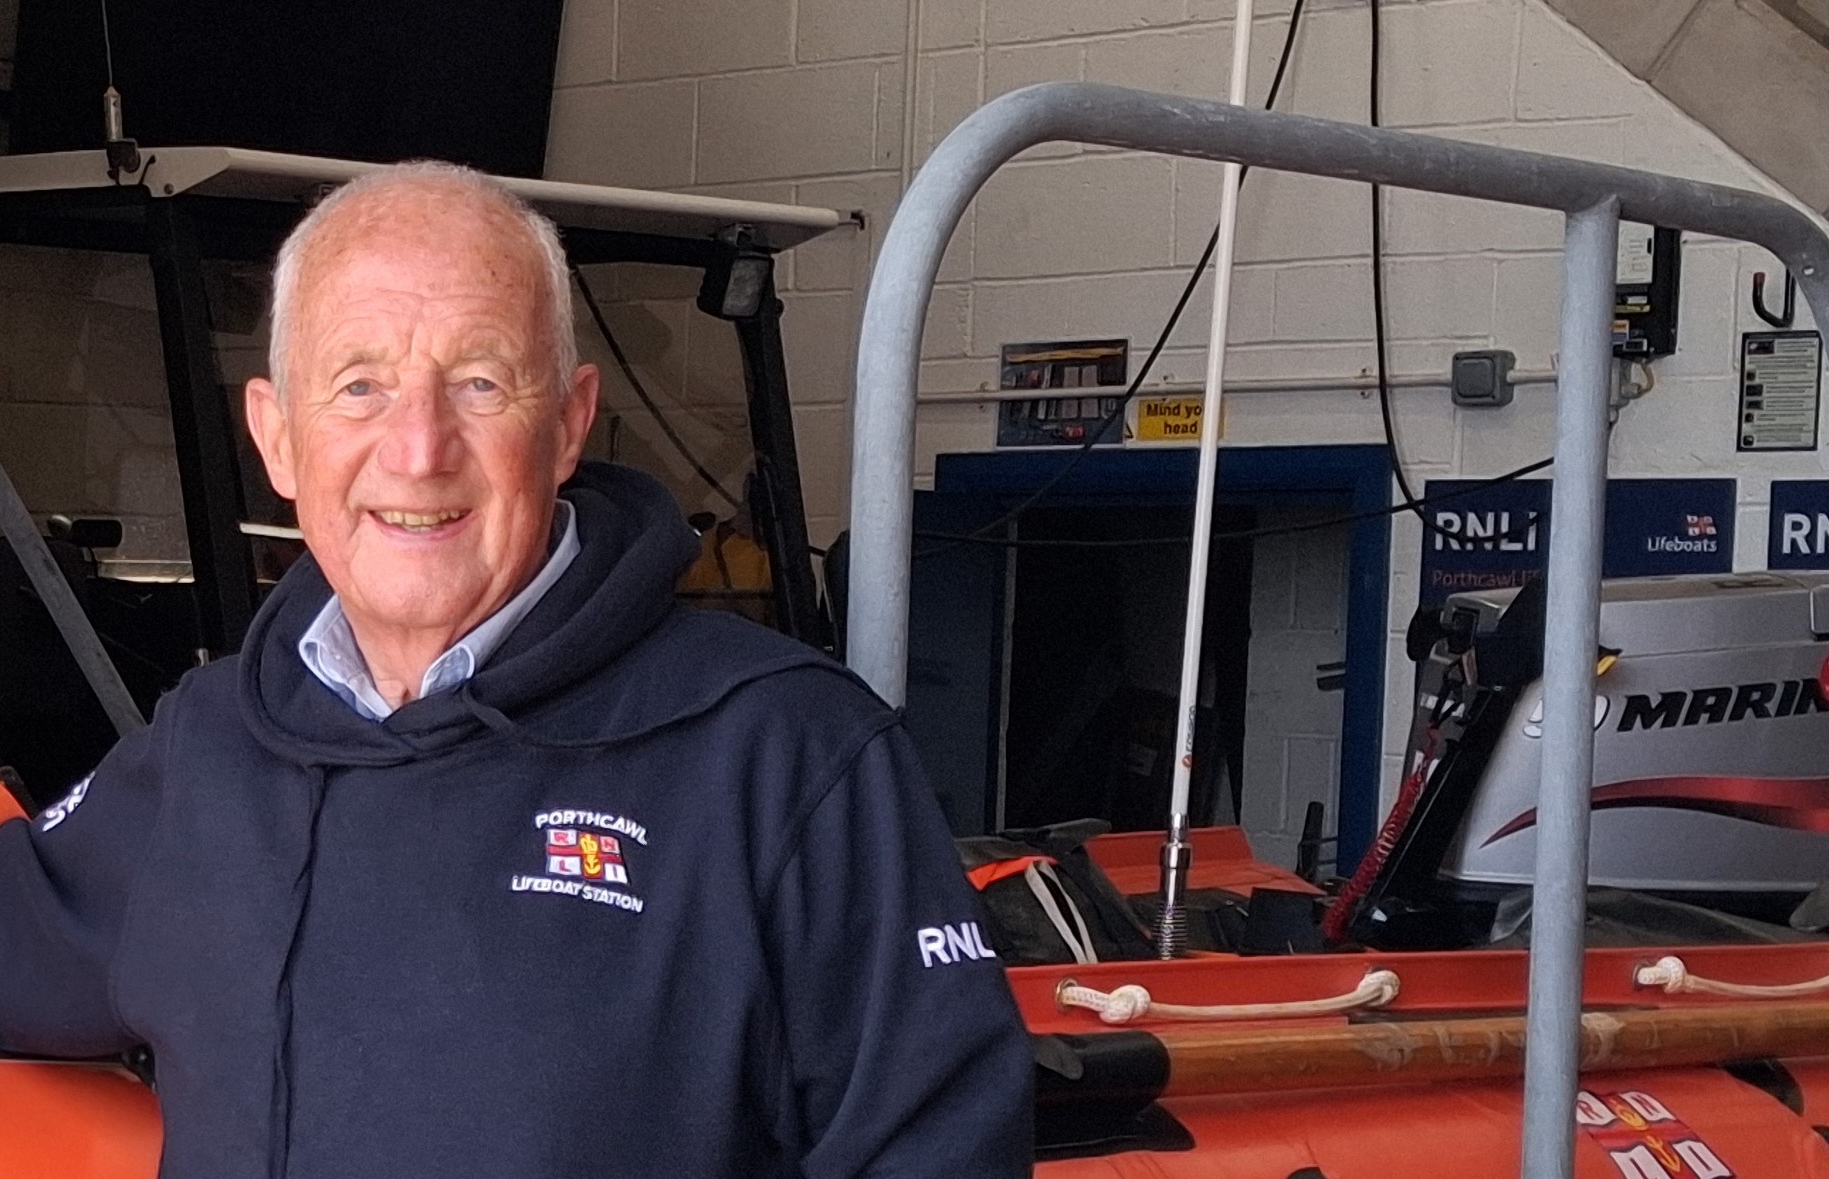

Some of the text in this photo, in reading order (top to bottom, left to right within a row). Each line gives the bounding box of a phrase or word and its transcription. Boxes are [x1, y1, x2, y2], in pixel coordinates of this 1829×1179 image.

[1146, 403, 1181, 417] Mind
[1163, 420, 1198, 435] head
[1434, 510, 1539, 552] RNLI
[1647, 535, 1718, 553] Lifeboats
[534, 809, 648, 846] PORTHCAWL
[511, 875, 643, 913] LIFEBOAT STATION
